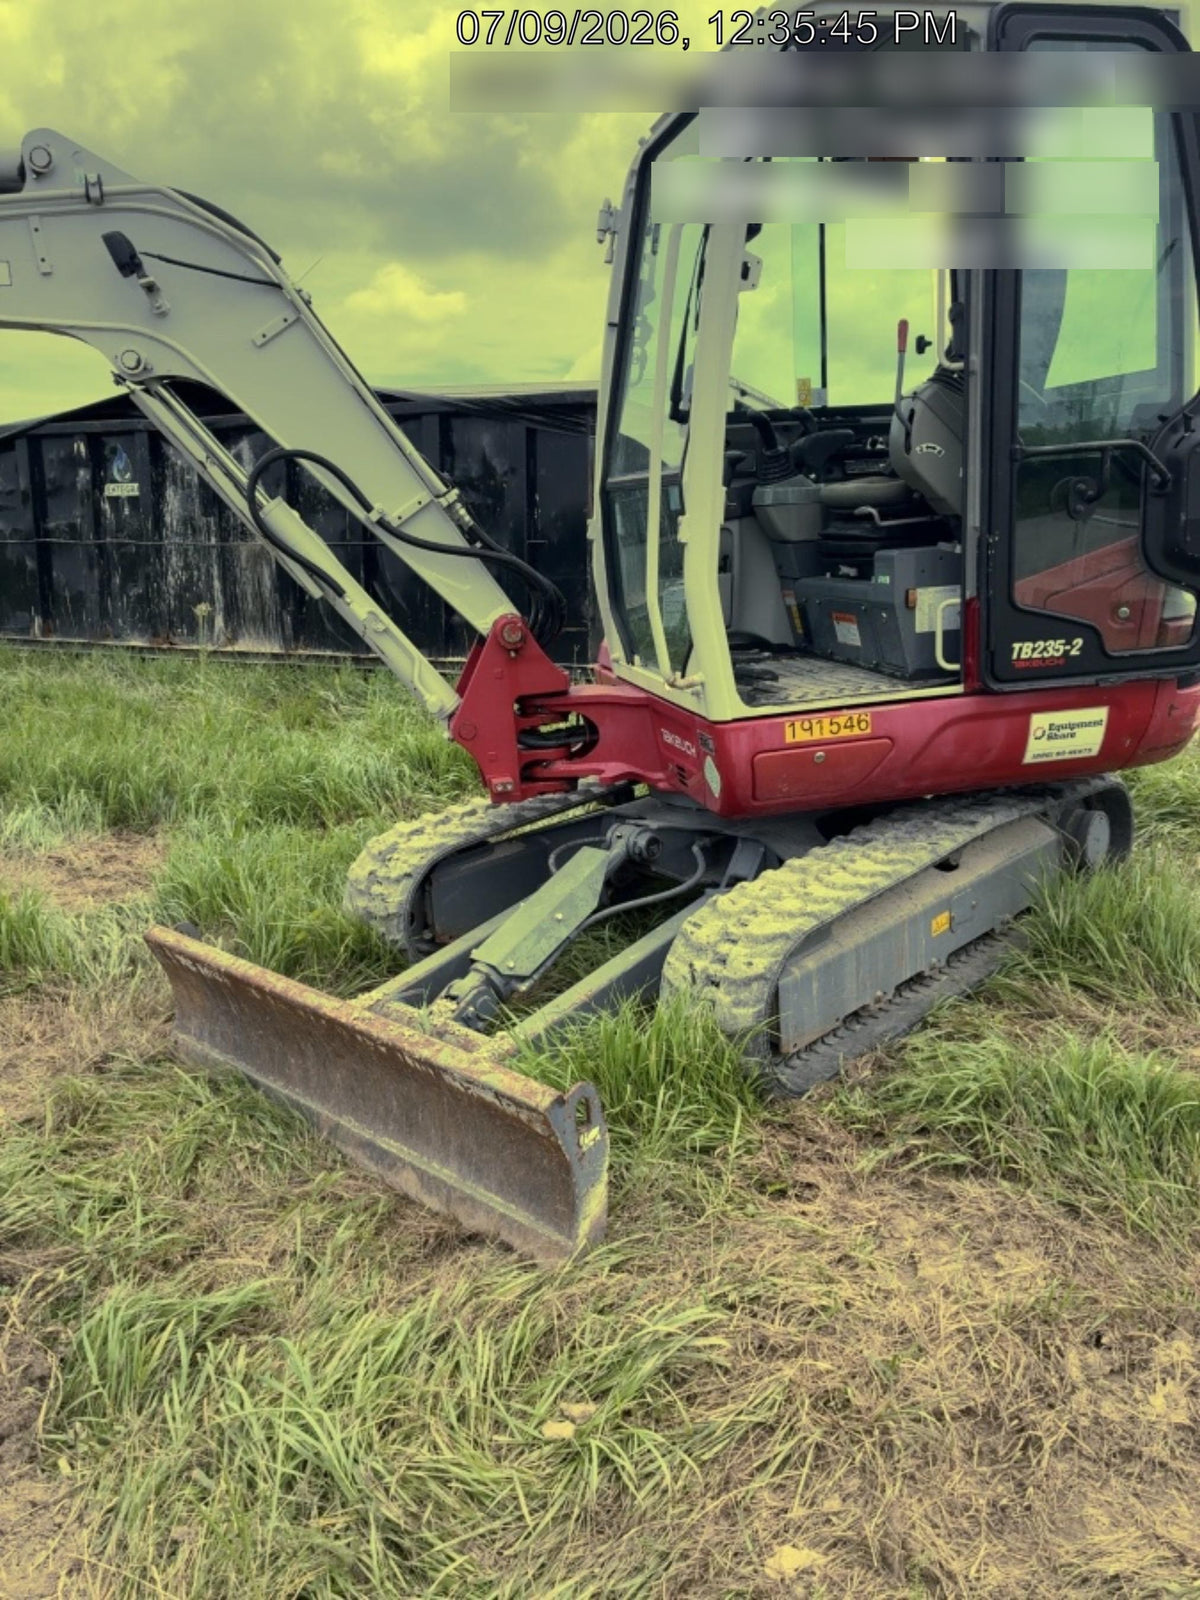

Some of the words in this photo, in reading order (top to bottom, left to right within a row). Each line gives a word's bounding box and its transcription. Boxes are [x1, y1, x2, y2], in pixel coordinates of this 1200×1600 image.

[1011, 637, 1084, 660] TB235-2
[788, 713, 869, 739] 191546
[1048, 719, 1104, 732] Equipment
